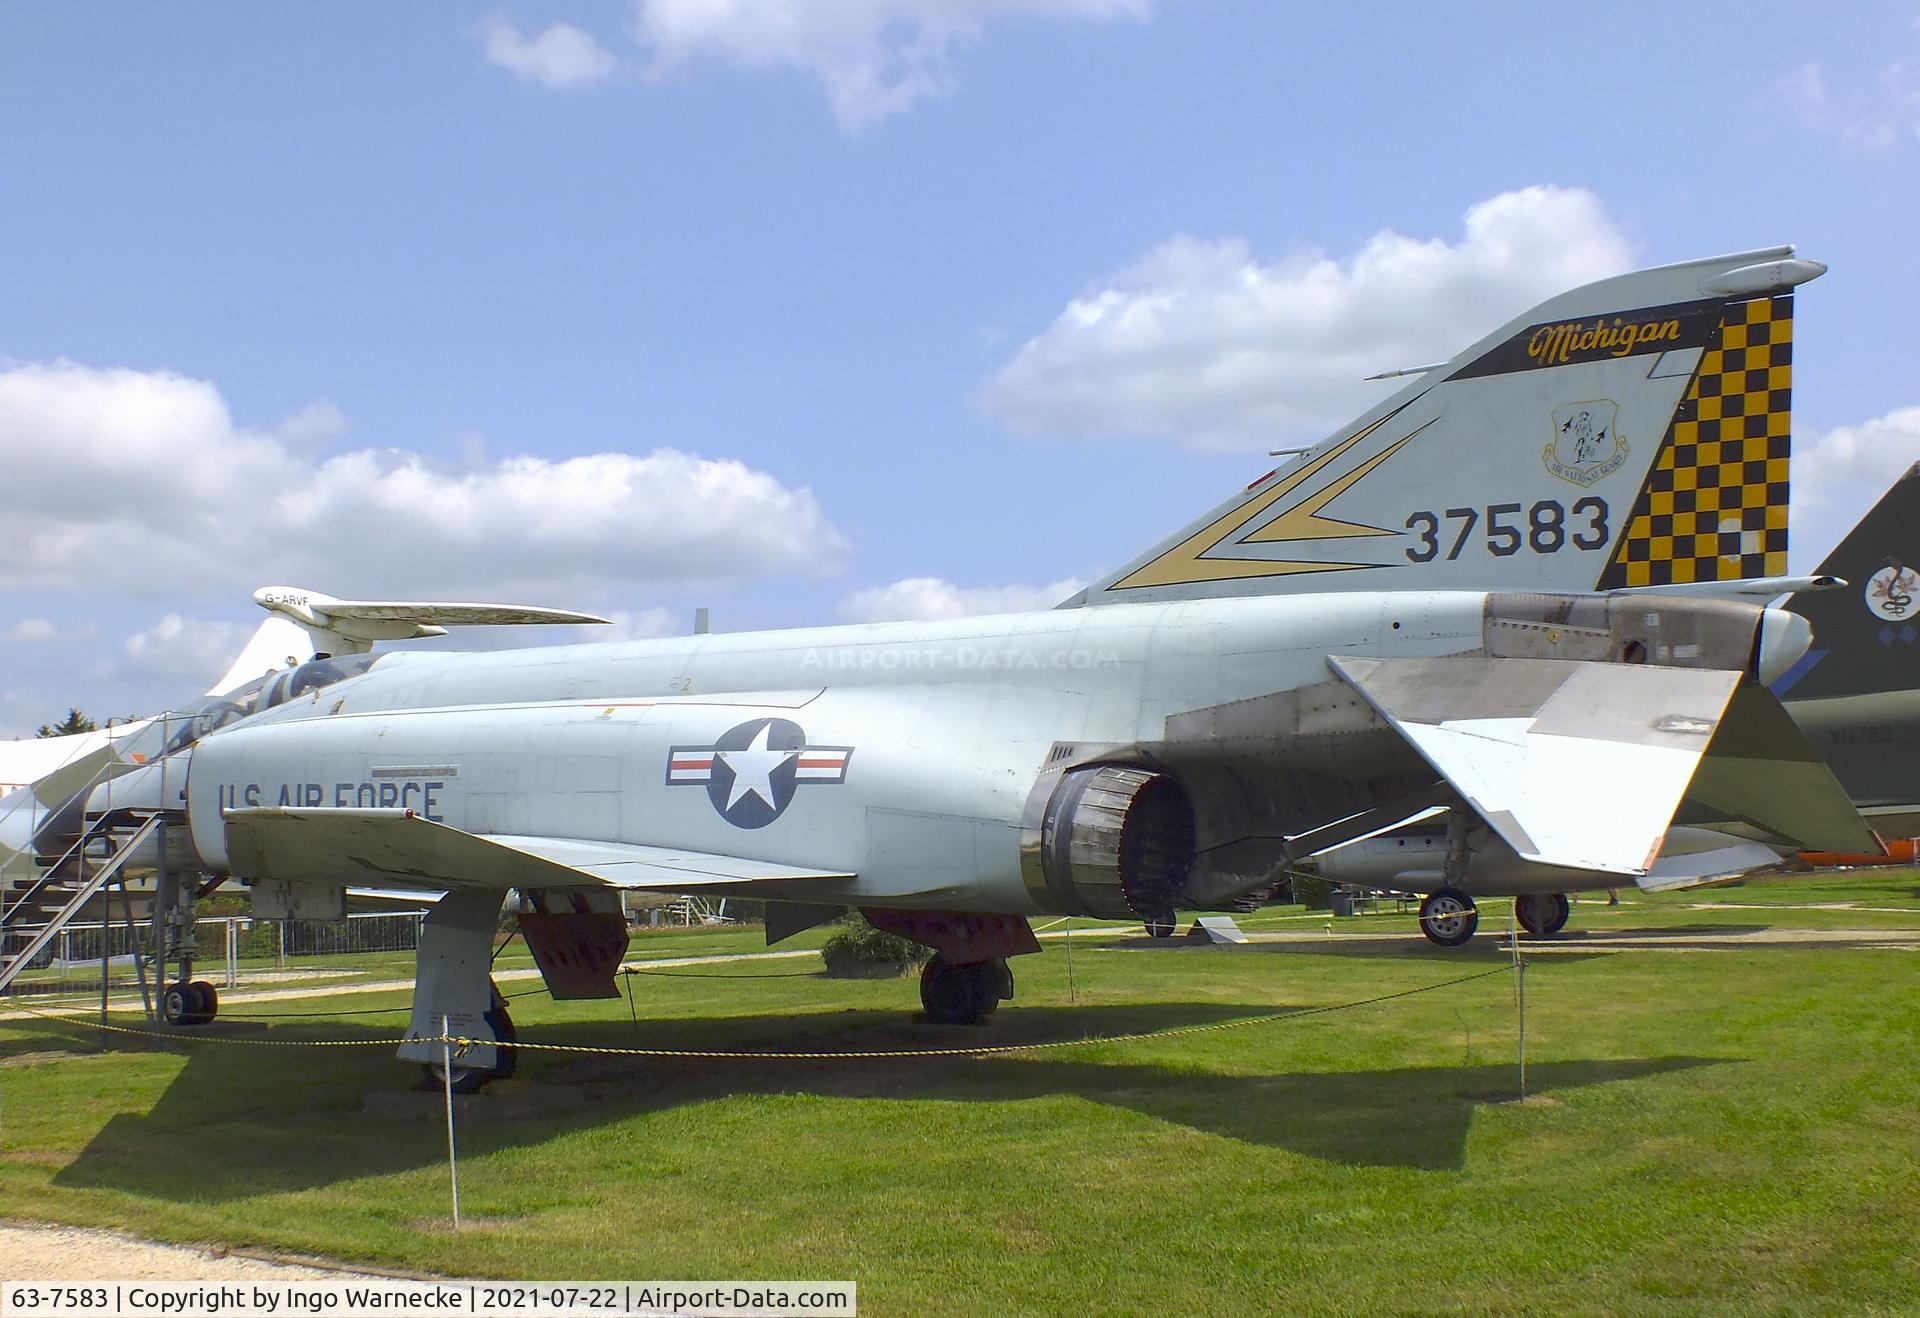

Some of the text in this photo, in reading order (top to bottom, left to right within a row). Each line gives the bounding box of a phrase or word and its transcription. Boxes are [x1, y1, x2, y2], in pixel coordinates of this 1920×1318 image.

[1528, 318, 1680, 364] Michigan
[1406, 496, 1609, 563] 37583
[265, 593, 309, 606] G-ARVF
[279, 783, 324, 808] AIR
[335, 782, 444, 822] FORCE
